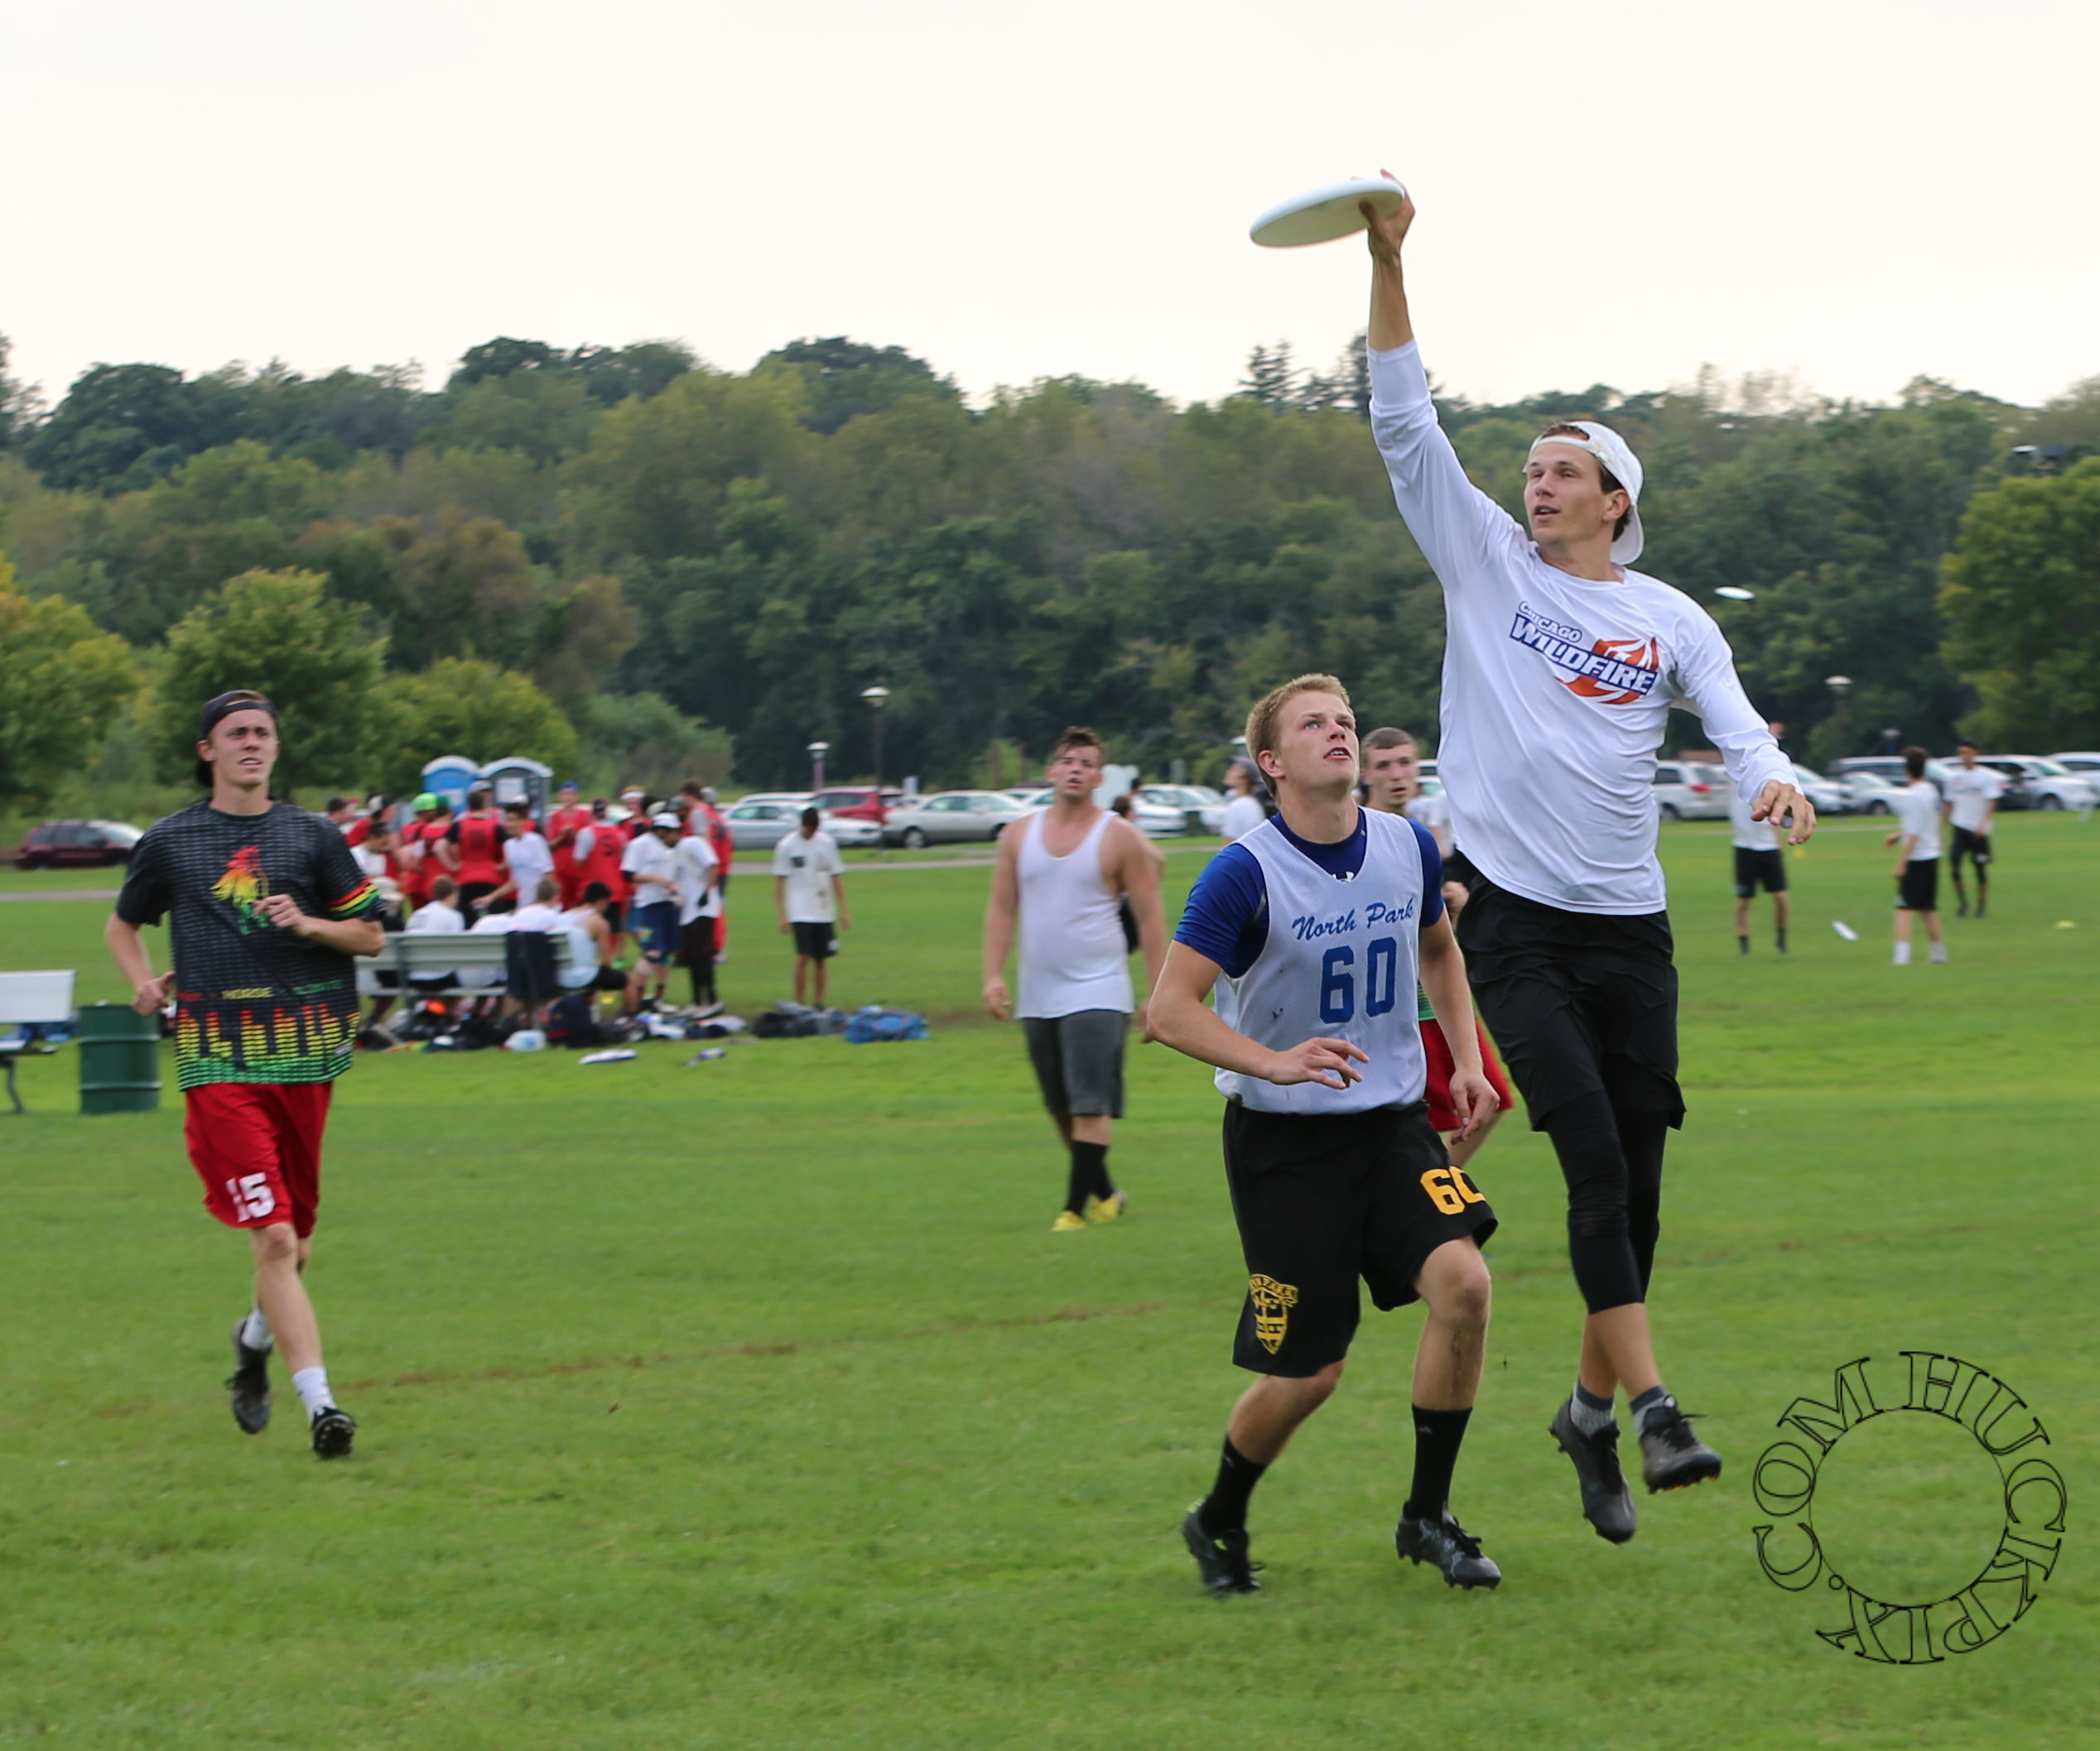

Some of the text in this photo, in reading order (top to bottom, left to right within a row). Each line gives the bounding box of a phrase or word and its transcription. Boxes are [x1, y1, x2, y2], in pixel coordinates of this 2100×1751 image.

[1510, 614, 1657, 695] WILDFIRE
[1292, 897, 1413, 940] North Park
[1319, 936, 1397, 1023] 60
